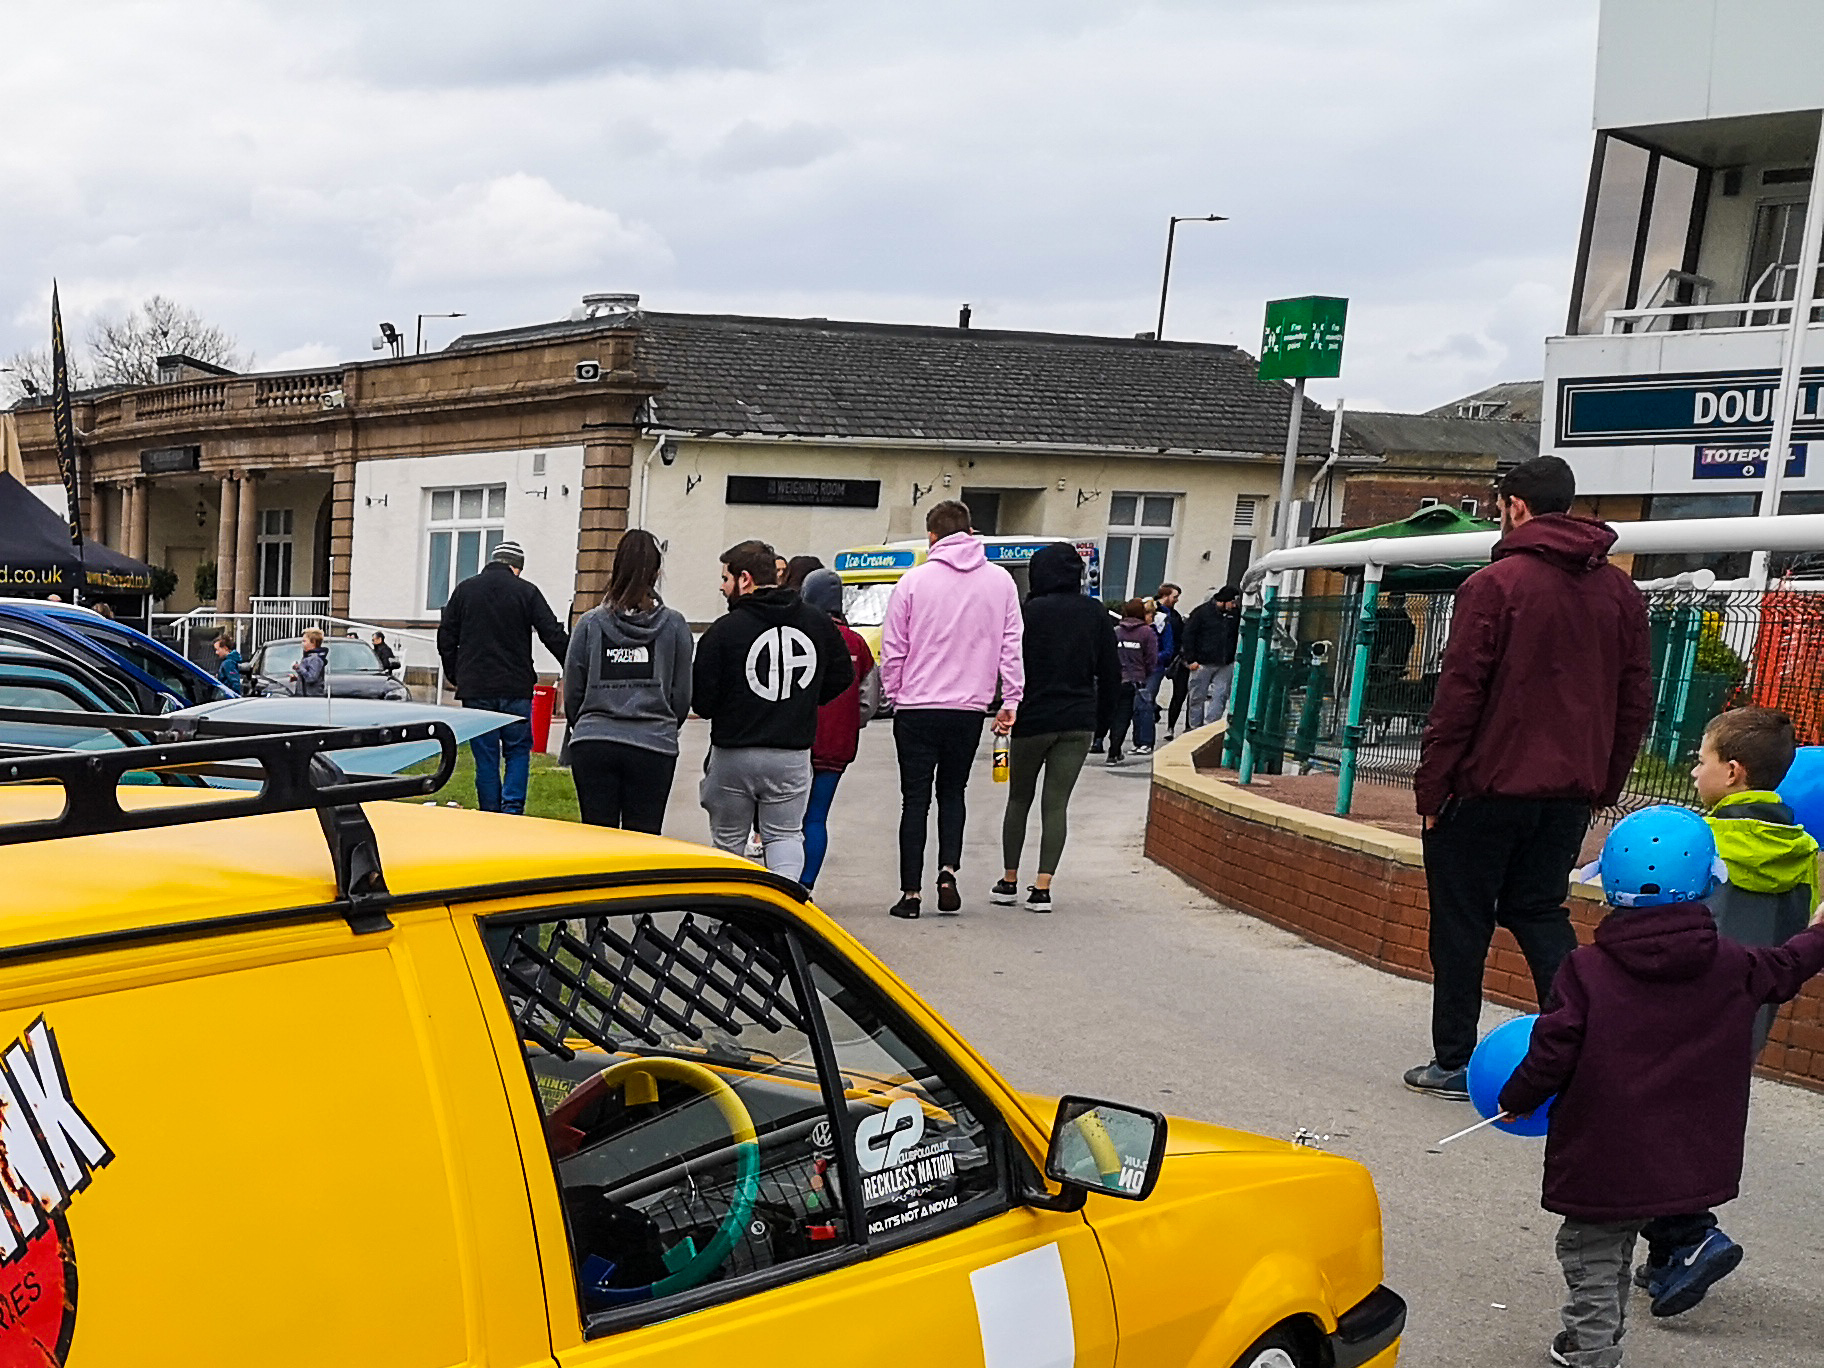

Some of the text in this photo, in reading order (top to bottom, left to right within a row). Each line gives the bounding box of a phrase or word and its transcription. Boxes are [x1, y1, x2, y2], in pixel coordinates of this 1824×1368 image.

[1693, 387, 1824, 424] DOUL
[844, 553, 896, 568] Ice Cream
[1000, 546, 1013, 559] Ice
[863, 1152, 955, 1201] RECKLESS NATION
[901, 1209, 919, 1224] NOT
[920, 1206, 929, 1218] A
[929, 1195, 958, 1213] NOVA!
